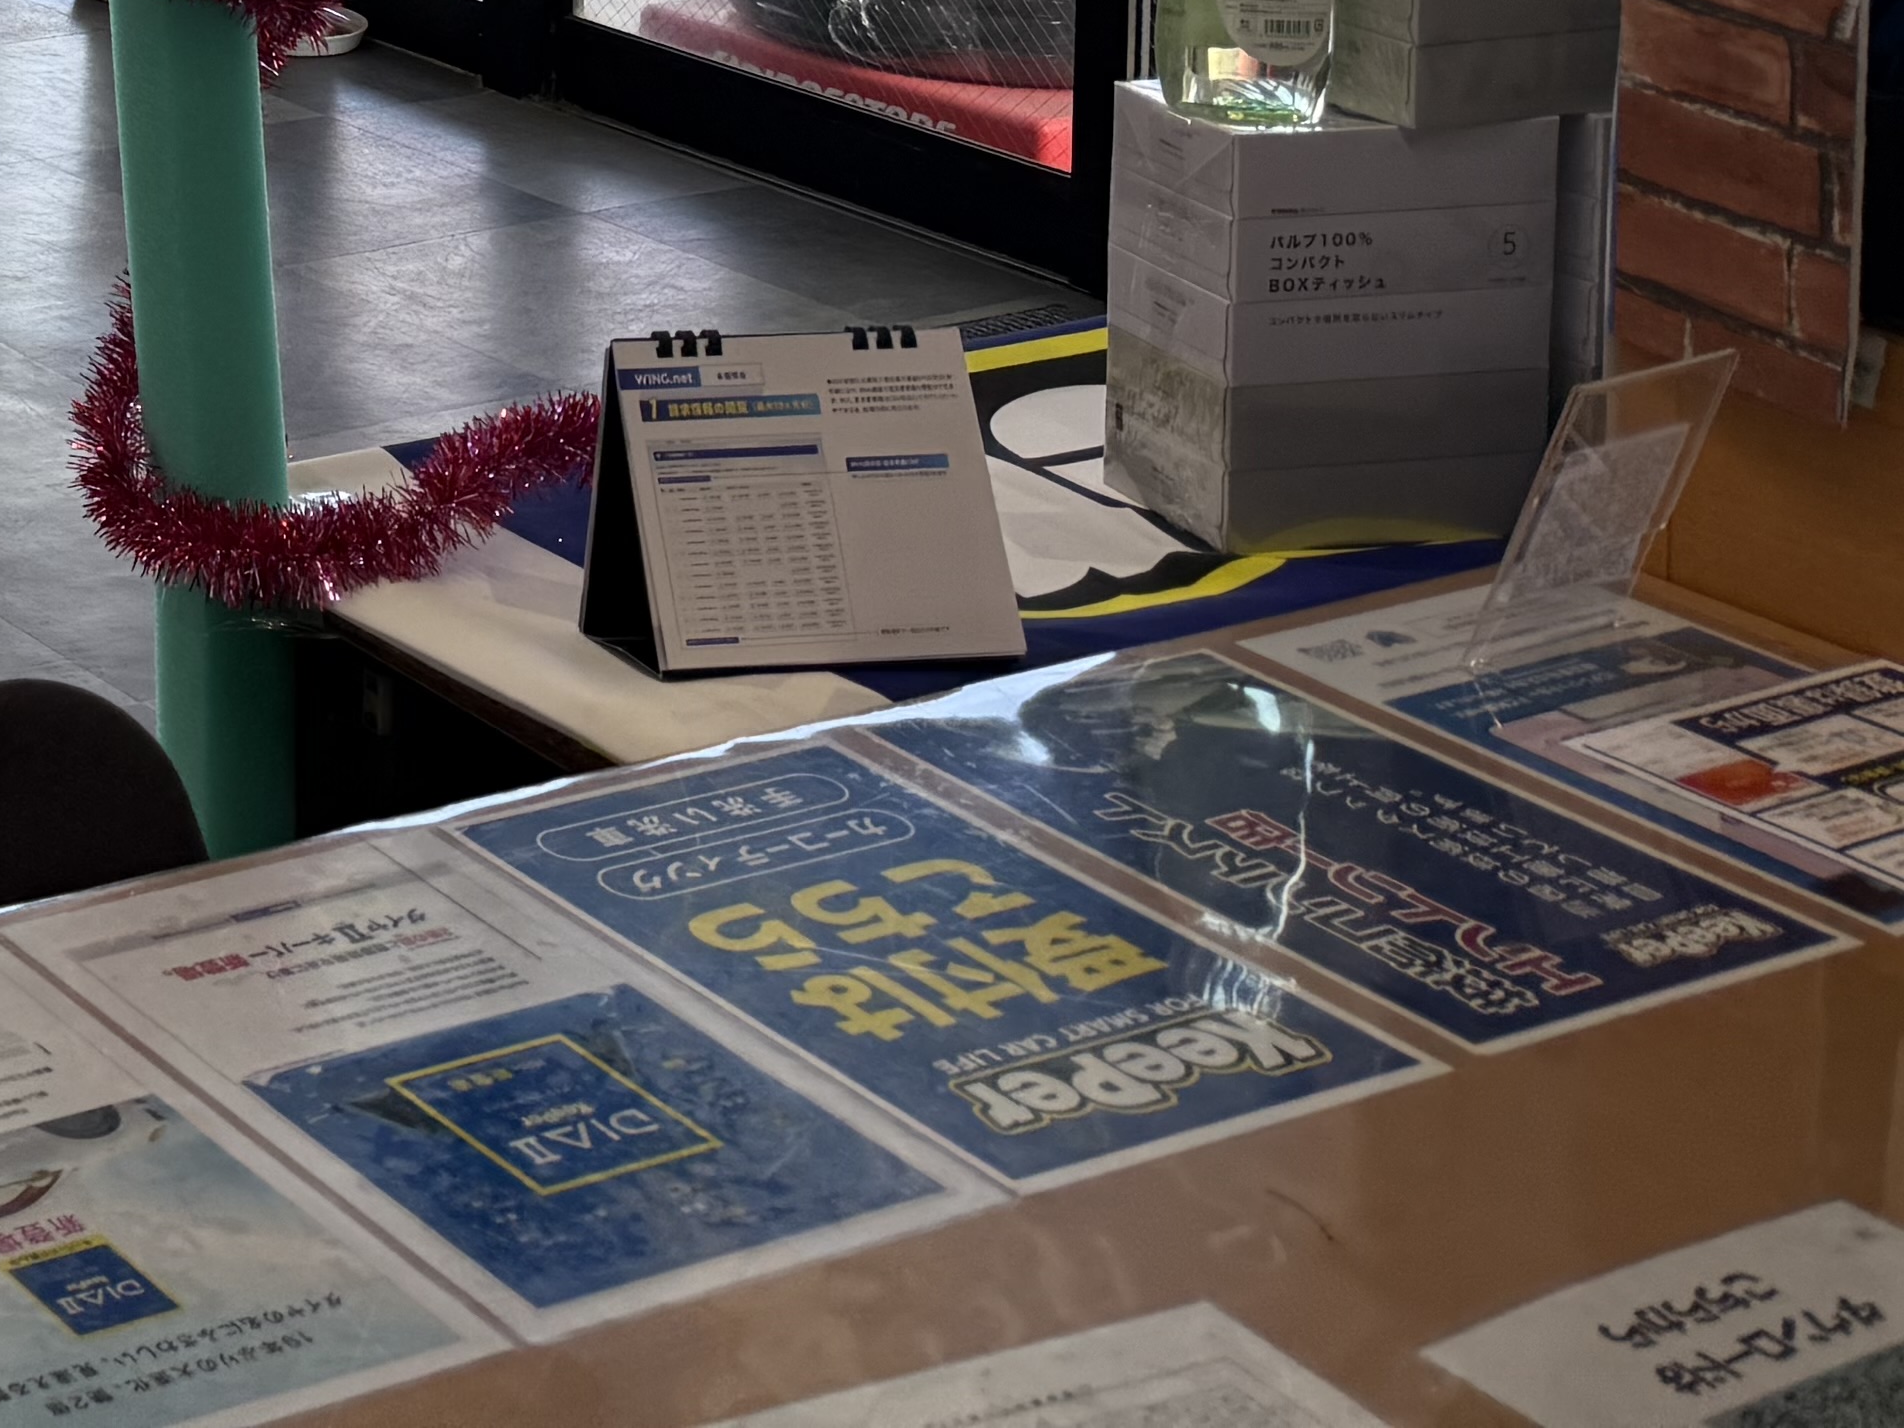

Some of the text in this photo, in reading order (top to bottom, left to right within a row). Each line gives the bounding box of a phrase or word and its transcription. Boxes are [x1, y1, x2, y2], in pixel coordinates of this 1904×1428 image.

[1269, 231, 1517, 256] パルプ100% 5
[1269, 254, 1347, 272] コンパクト
[1268, 275, 1388, 294] BOXティッシュ
[585, 785, 795, 849] 手洗い洗車
[628, 815, 889, 897] カーコーティング
[687, 857, 1040, 973] こちら
[792, 908, 1168, 1042] 受付は
[1007, 1028, 1057, 1058] CAR
[1063, 1001, 1150, 1043] SMART
[931, 1042, 1001, 1074] LIFE
[974, 1013, 1320, 1130] KeePer
